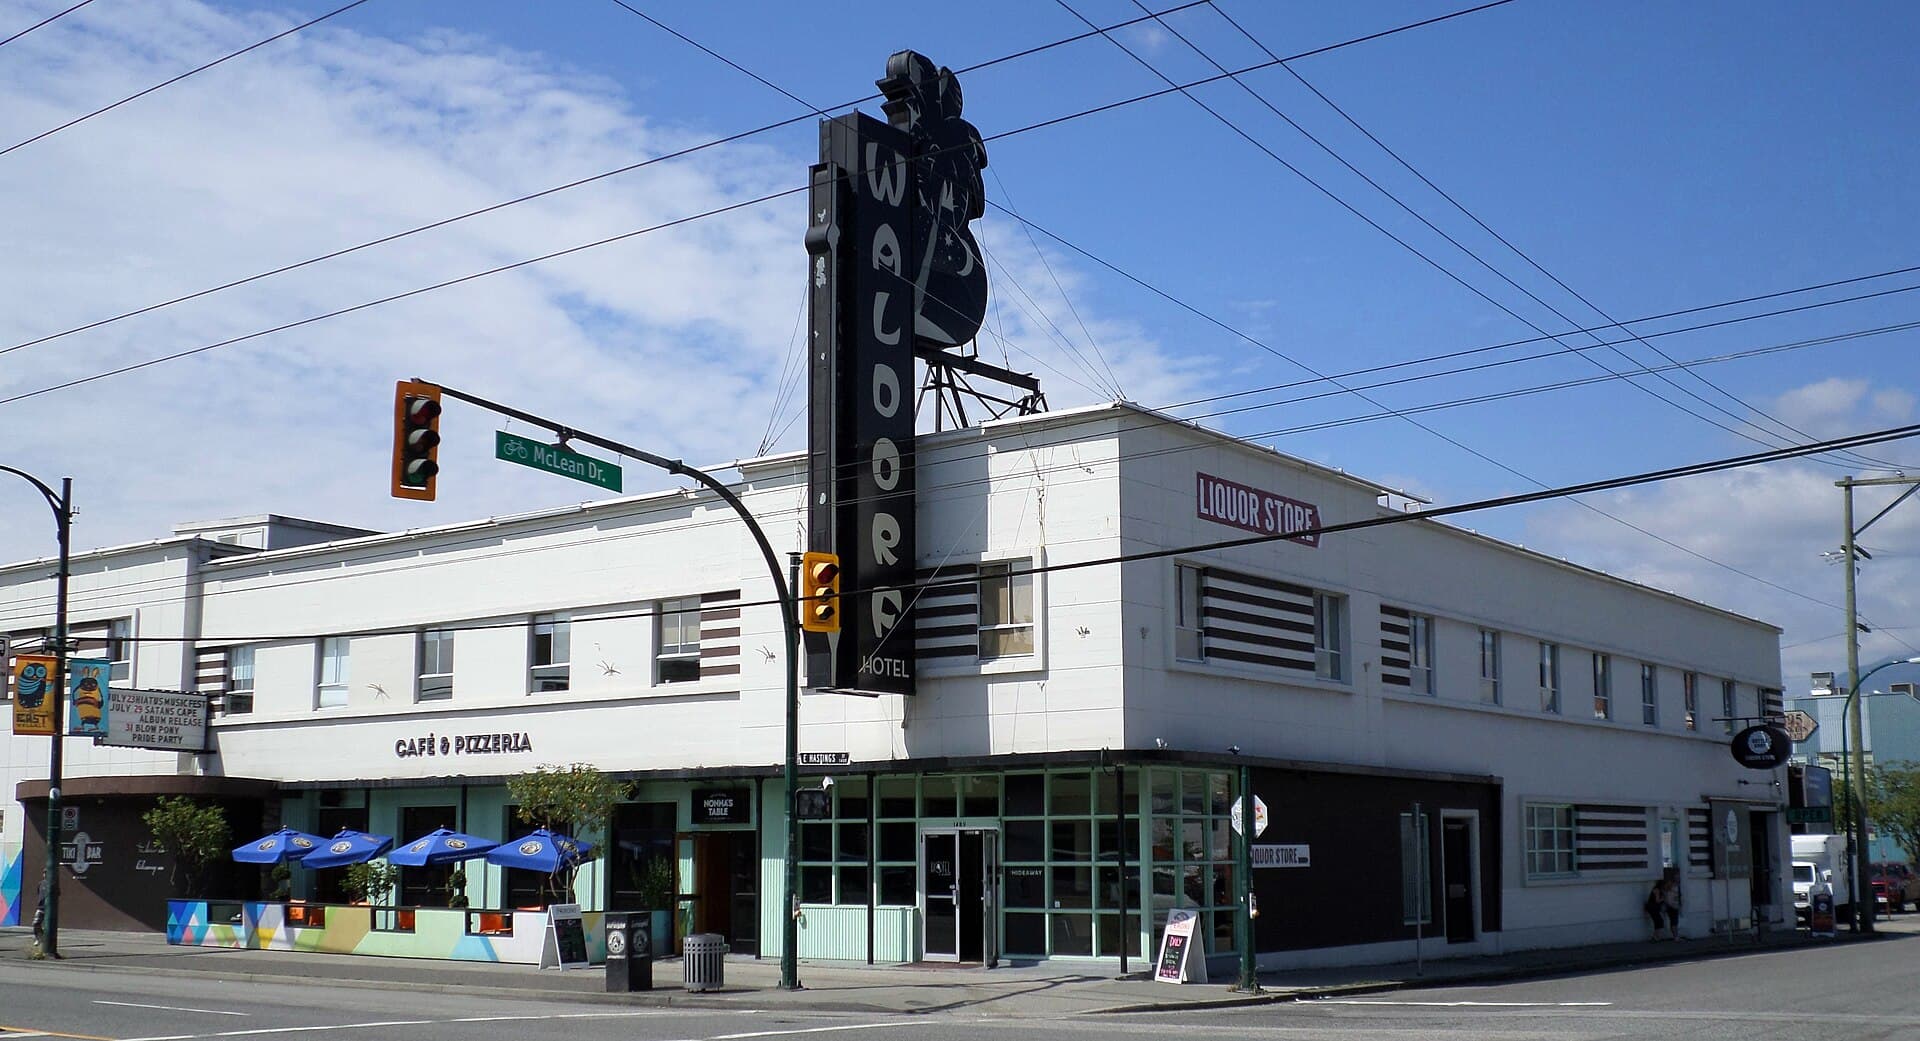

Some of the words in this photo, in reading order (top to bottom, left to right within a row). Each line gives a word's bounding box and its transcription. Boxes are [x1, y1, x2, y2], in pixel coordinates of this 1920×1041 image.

[865, 140, 905, 641] WALDORF
[533, 446, 584, 477] McLean
[588, 464, 606, 483] Dr.
[1199, 478, 1260, 528] LIQUOR
[1264, 497, 1314, 542] STORE
[863, 655, 910, 678] HOTEL
[109, 703, 131, 712] JULY
[145, 705, 175, 715] SATANS
[177, 708, 198, 717] CAPE
[16, 711, 48, 727] EAST
[140, 715, 166, 724] ALBUM
[168, 716, 202, 727] RELEASE
[135, 724, 157, 733] BLOW
[159, 725, 180, 735] PONY
[132, 733, 156, 743] PRIDE
[158, 735, 183, 745] PARTY
[395, 732, 435, 758] CAFÉ
[440, 736, 450, 755] &
[455, 732, 532, 755] PIZZERIA
[803, 754, 808, 763] E
[809, 753, 836, 763] HASTINGS
[708, 807, 729, 816] TABLE
[62, 847, 76, 859] TIKI
[86, 846, 102, 859] BAR
[1251, 848, 1275, 865] IQUOR
[1276, 847, 1298, 865] STORE
